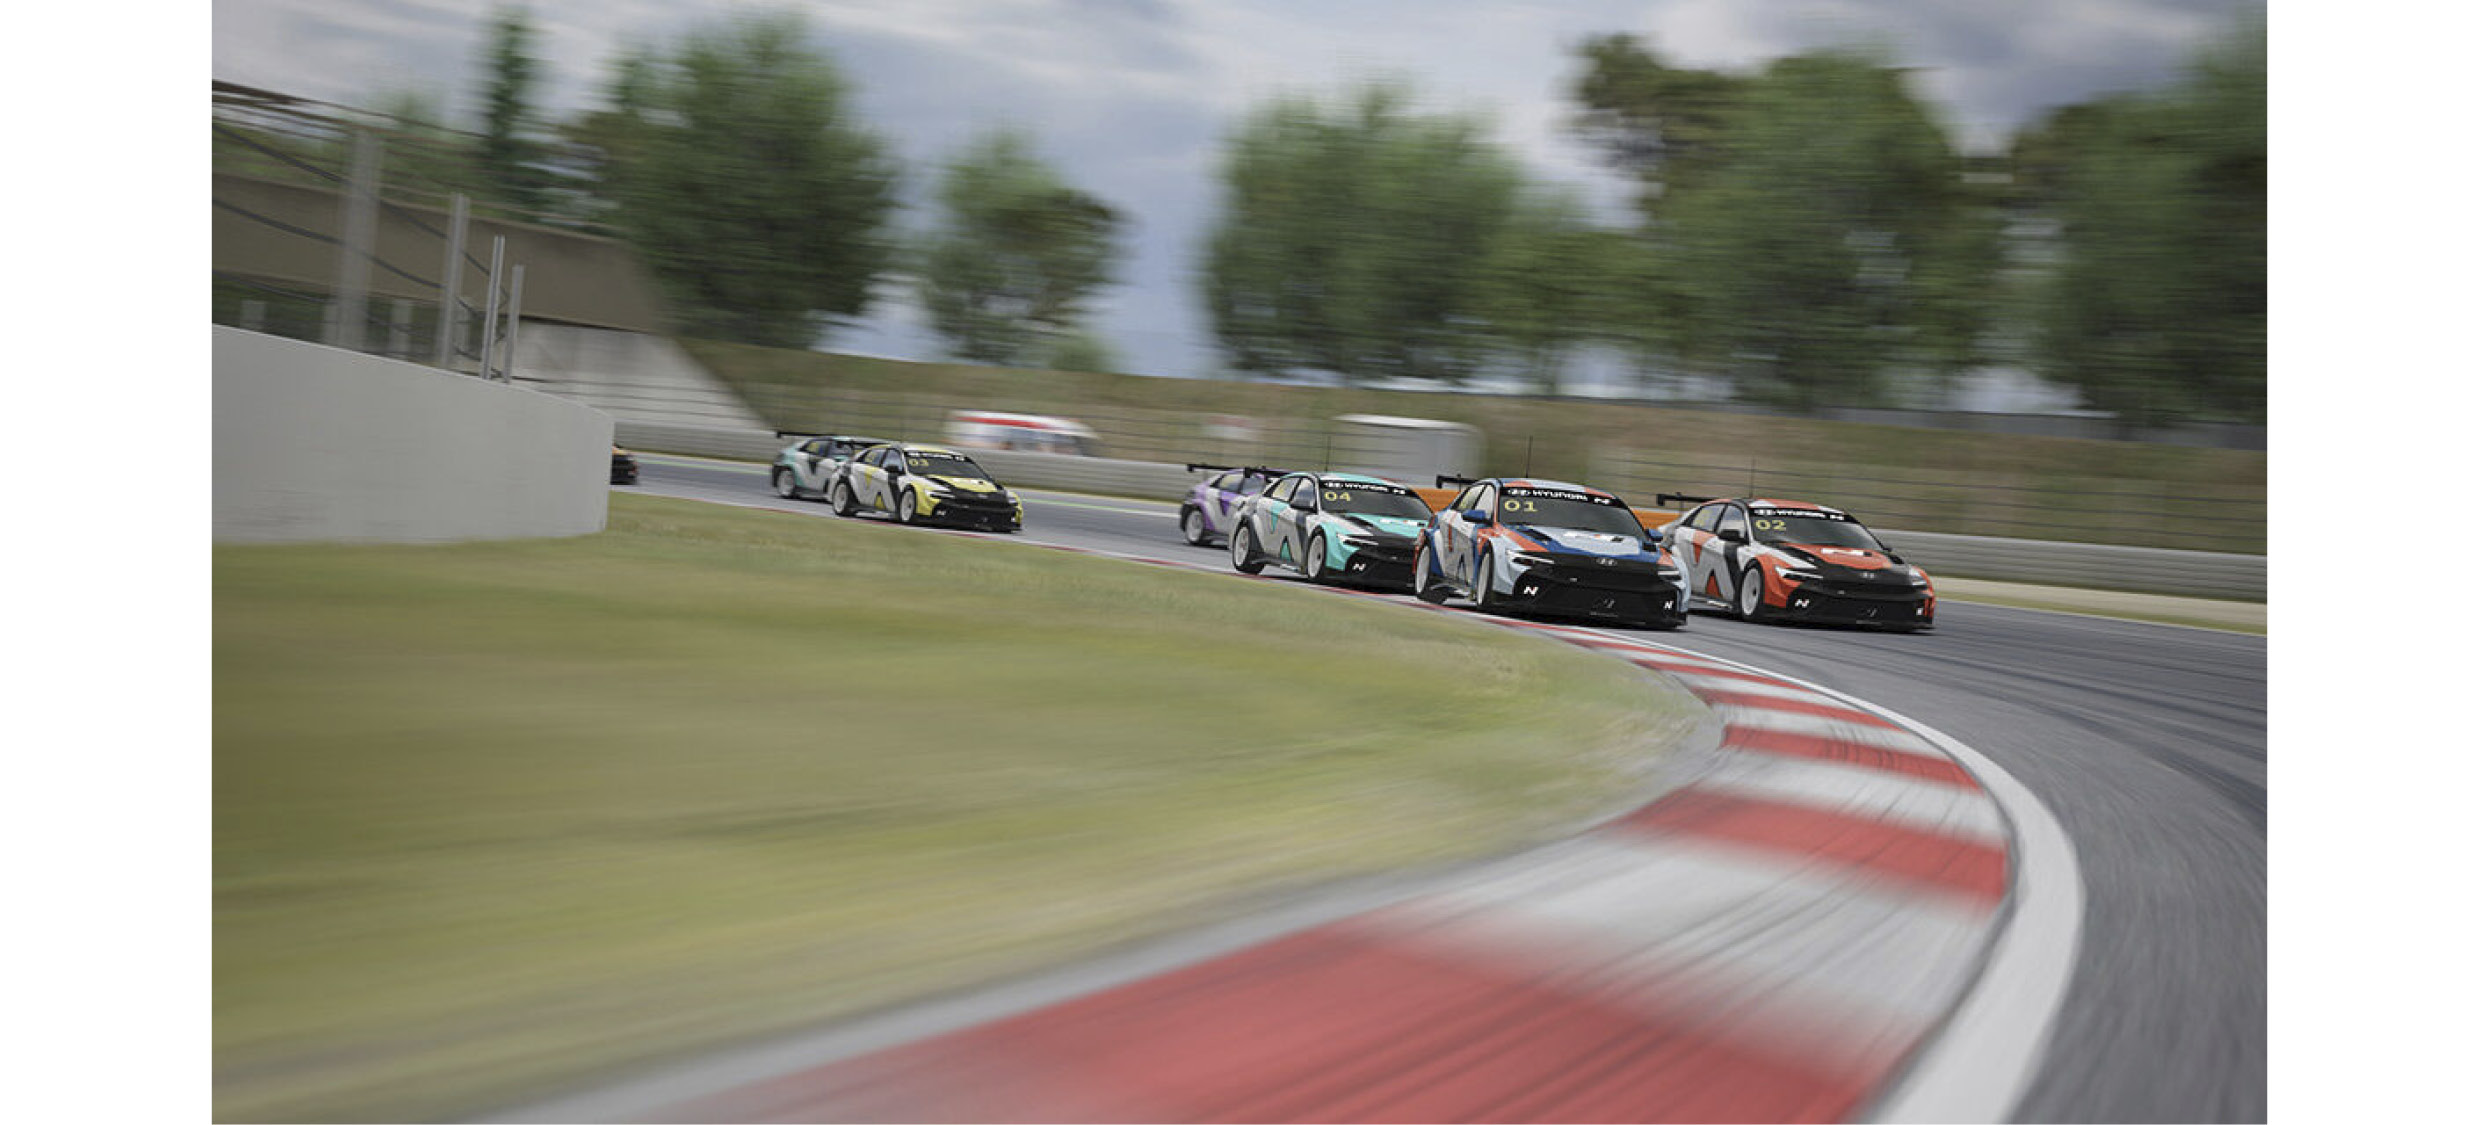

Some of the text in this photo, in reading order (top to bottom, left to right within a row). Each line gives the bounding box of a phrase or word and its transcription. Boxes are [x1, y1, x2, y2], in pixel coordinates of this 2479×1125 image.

[1324, 491, 1351, 502] 04
[1533, 490, 1588, 501] HYUNDAI
[1504, 499, 1538, 513] 01
[1756, 519, 1786, 532] 02
[1524, 585, 1539, 596] N
[1663, 600, 1675, 610] N
[1795, 599, 1810, 608] N
